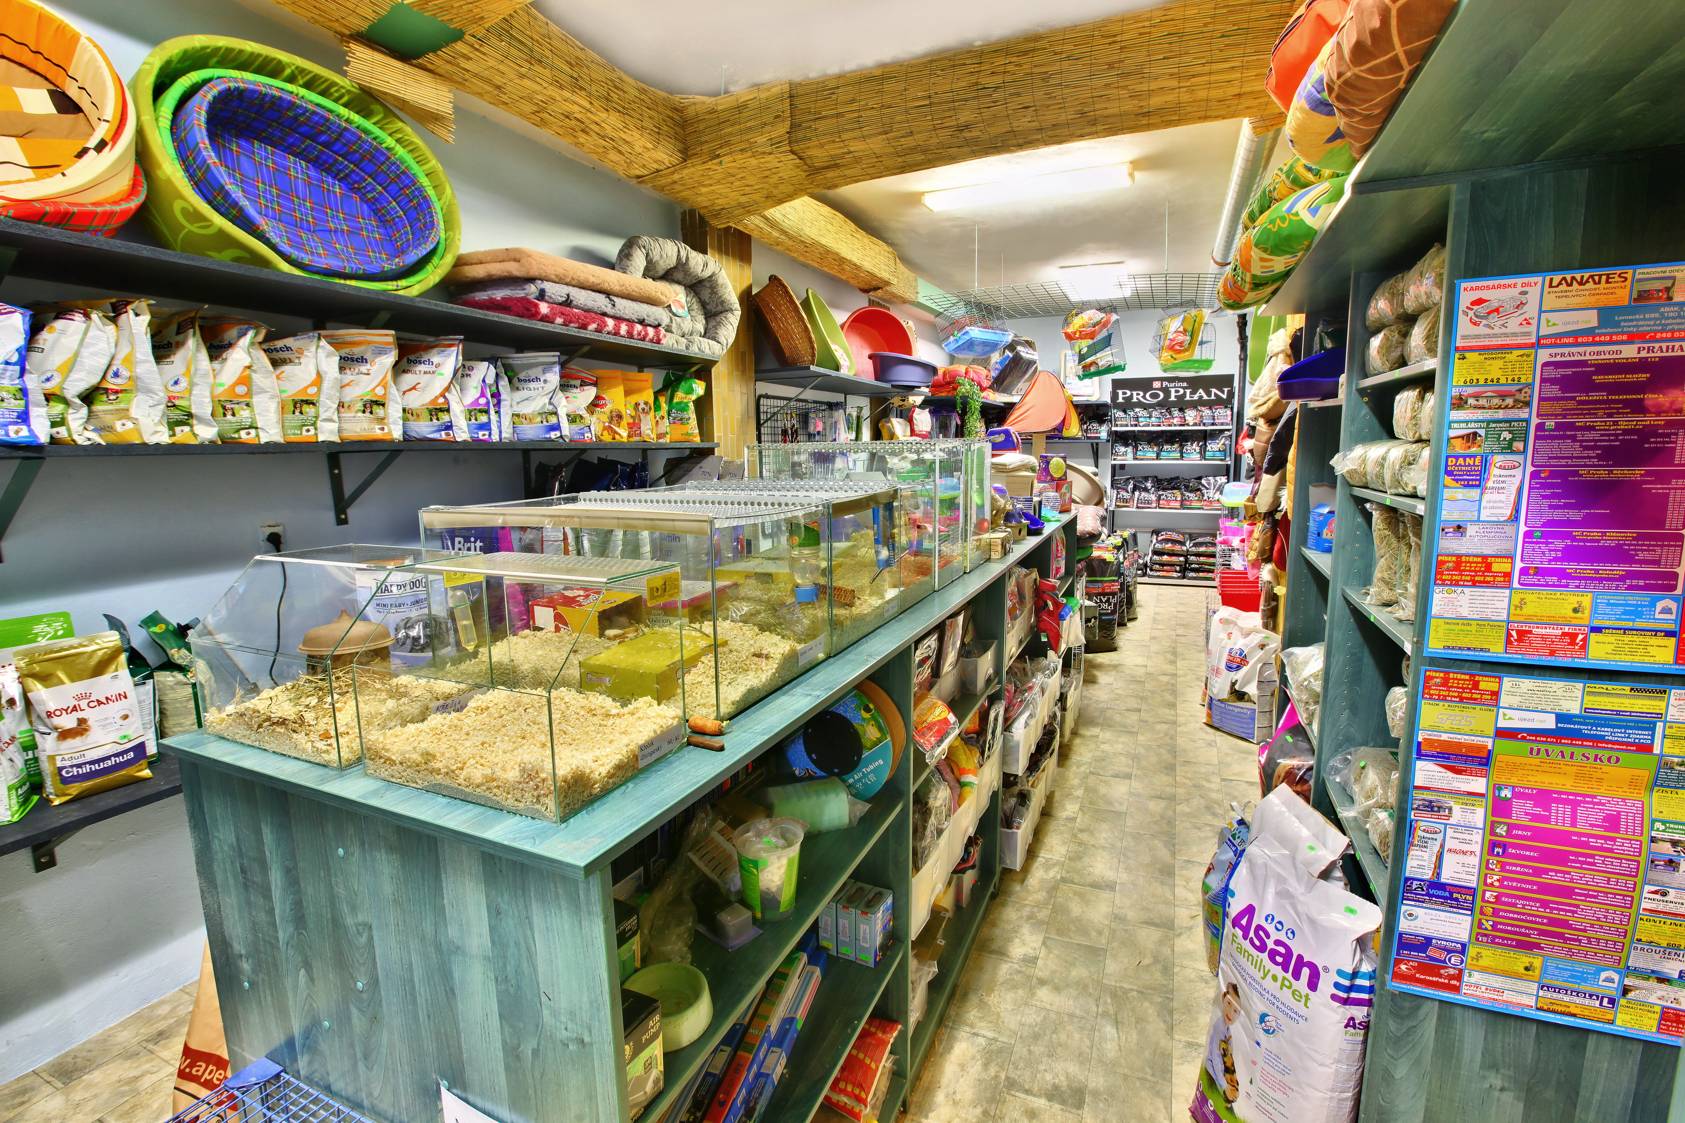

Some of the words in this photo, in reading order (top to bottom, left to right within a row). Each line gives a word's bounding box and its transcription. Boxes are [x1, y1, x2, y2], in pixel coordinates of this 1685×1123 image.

[1548, 272, 1628, 289] LANATES
[1548, 349, 1587, 360] SPRÁVNÍ
[1589, 349, 1622, 358] OBVOD
[1637, 343, 1684, 355] PRAHA
[407, 357, 434, 369] bosch
[402, 368, 423, 376] ADULT
[517, 376, 542, 387] bosch
[1463, 377, 1480, 385] 603
[1484, 376, 1500, 384] 242
[516, 388, 546, 396] LIGHT
[1116, 389, 1165, 404] PRO
[1168, 387, 1232, 402] PLAN
[1448, 456, 1482, 466] DANĚ
[455, 537, 484, 553] Brit
[1092, 594, 1118, 604] PLAN
[1434, 588, 1466, 597] GEOKA
[46, 703, 86, 720] ROYAL
[87, 691, 128, 710] CANIN
[59, 753, 87, 764] Adult
[1528, 747, 1622, 765] ÚVALSKO
[61, 752, 135, 777] Chihuahua
[1429, 889, 1450, 898] VODA
[1452, 892, 1474, 901] PLYN
[1231, 903, 1321, 993] Asan
[1432, 938, 1462, 949] EVROPA
[1230, 932, 1270, 981] Family
[1279, 977, 1313, 1009] Pet
[1542, 986, 1600, 1001] AUTOŠKOLA
[649, 1013, 661, 1029] AIR
[641, 1021, 662, 1045] PUMP
